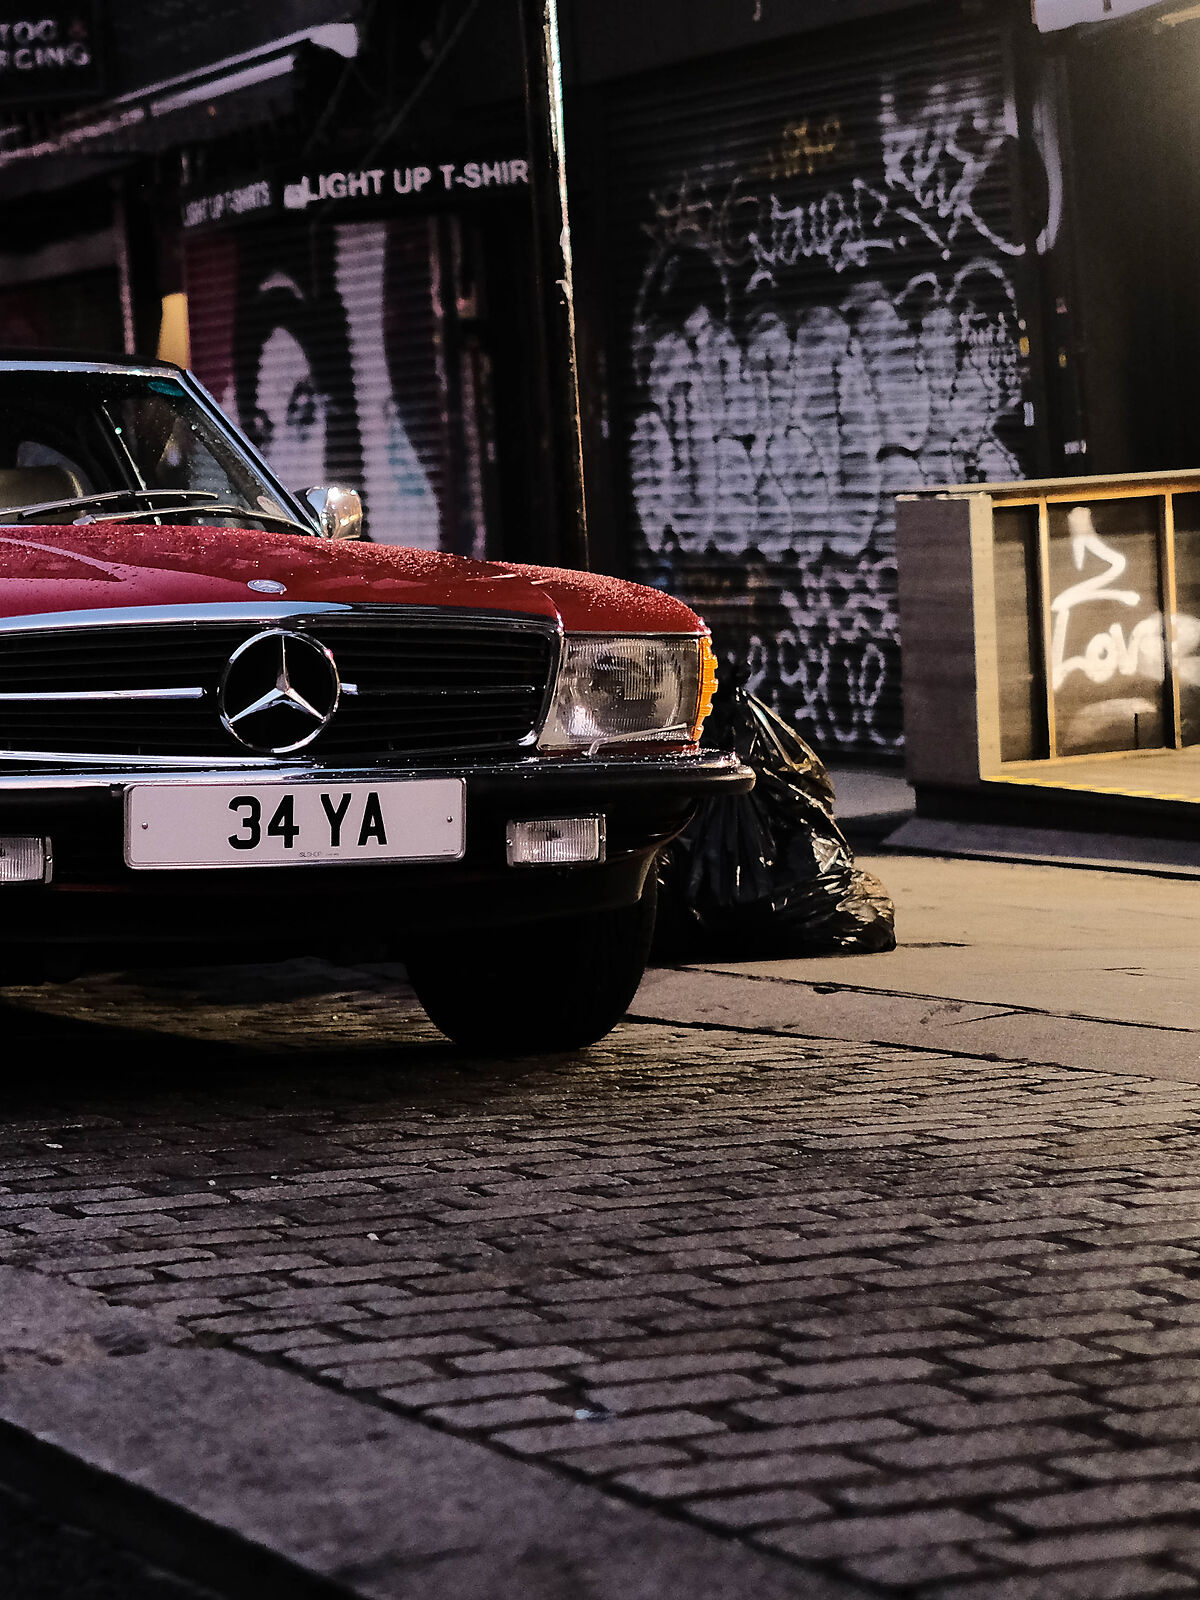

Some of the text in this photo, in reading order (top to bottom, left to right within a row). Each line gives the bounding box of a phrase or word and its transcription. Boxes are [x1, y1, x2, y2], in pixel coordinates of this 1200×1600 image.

[301, 169, 385, 200] LIGHT
[393, 167, 432, 193] UP
[228, 792, 388, 850] 34 YA
